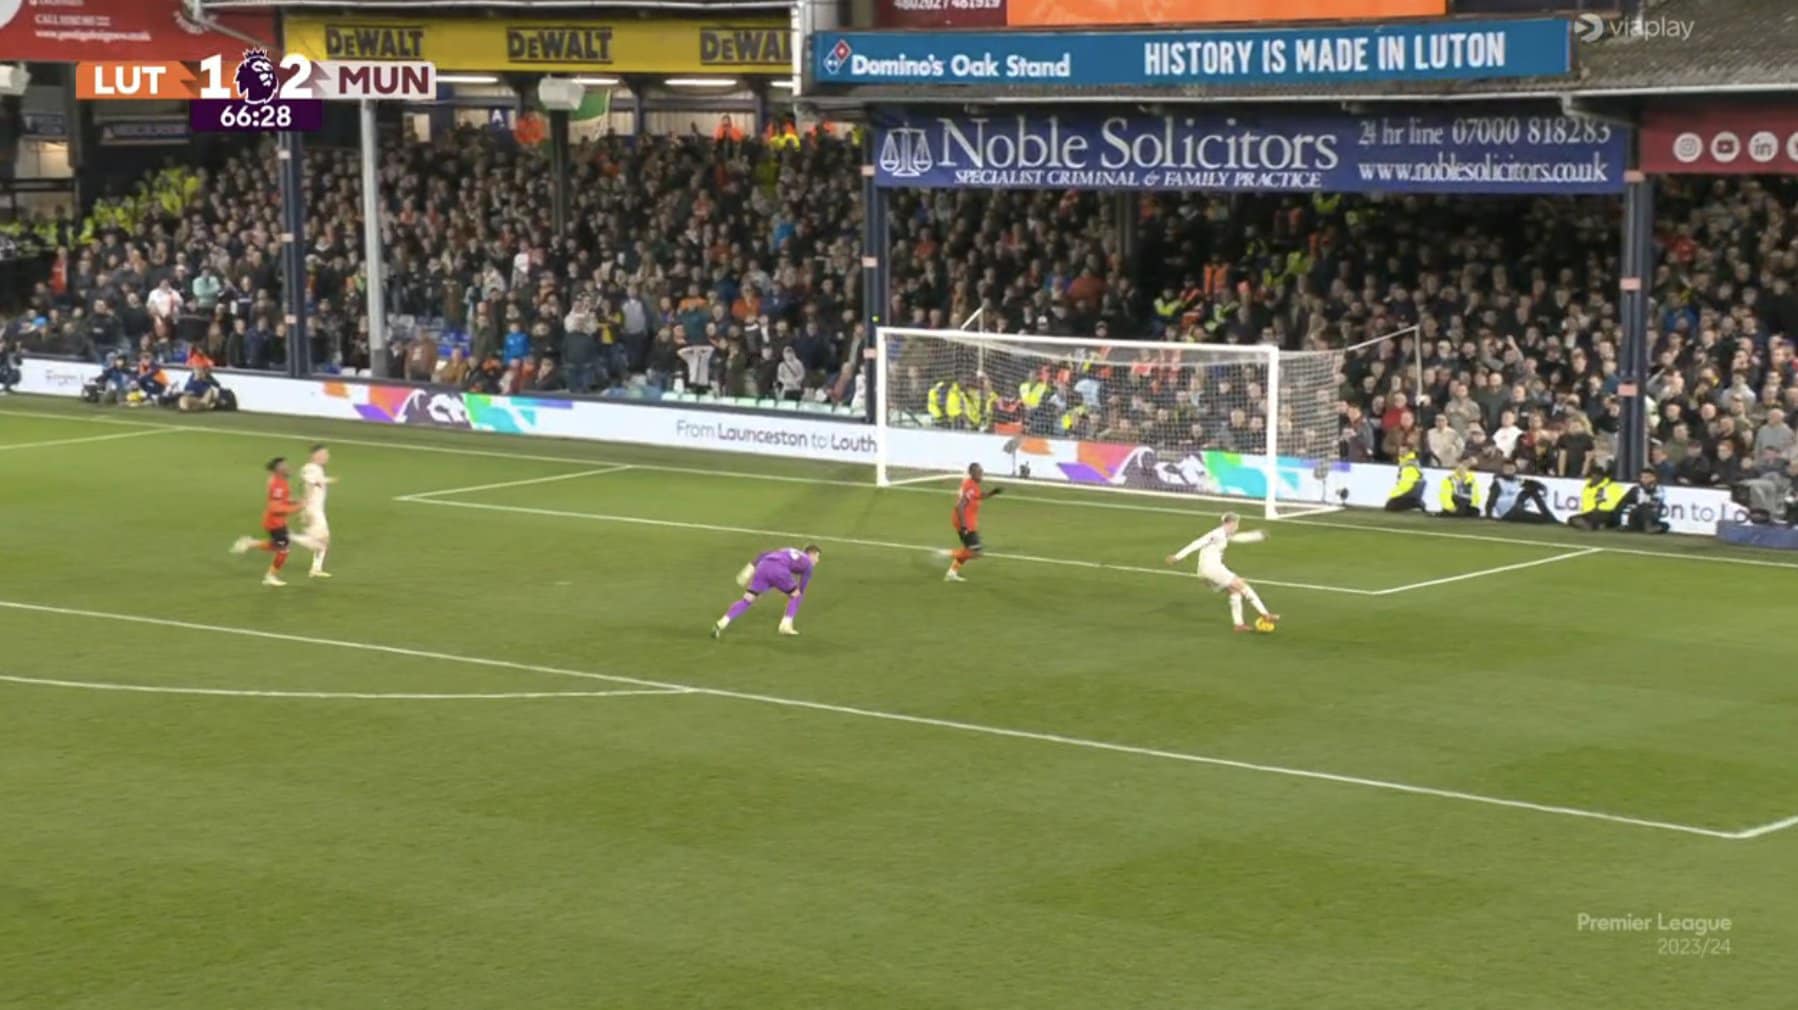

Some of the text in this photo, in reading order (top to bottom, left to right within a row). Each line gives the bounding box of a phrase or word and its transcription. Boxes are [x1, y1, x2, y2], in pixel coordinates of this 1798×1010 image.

[852, 52, 1070, 78] Domino's Oak Stand
[1144, 33, 1505, 75] HISTORY IS MADE IN LUTON
[937, 117, 1339, 168] Noble Solicitors
[1382, 118, 1404, 145] hr
[1408, 117, 1444, 145] line
[1453, 118, 1520, 144] 07000
[954, 170, 1322, 189] SPECIALIST CRIMINAL & FAMILY PRACTICE
[1358, 152, 1608, 183] www.noblesolicitors.co.uk
[676, 420, 878, 454] From Launceston to Louth
[1692, 503, 1716, 522] to
